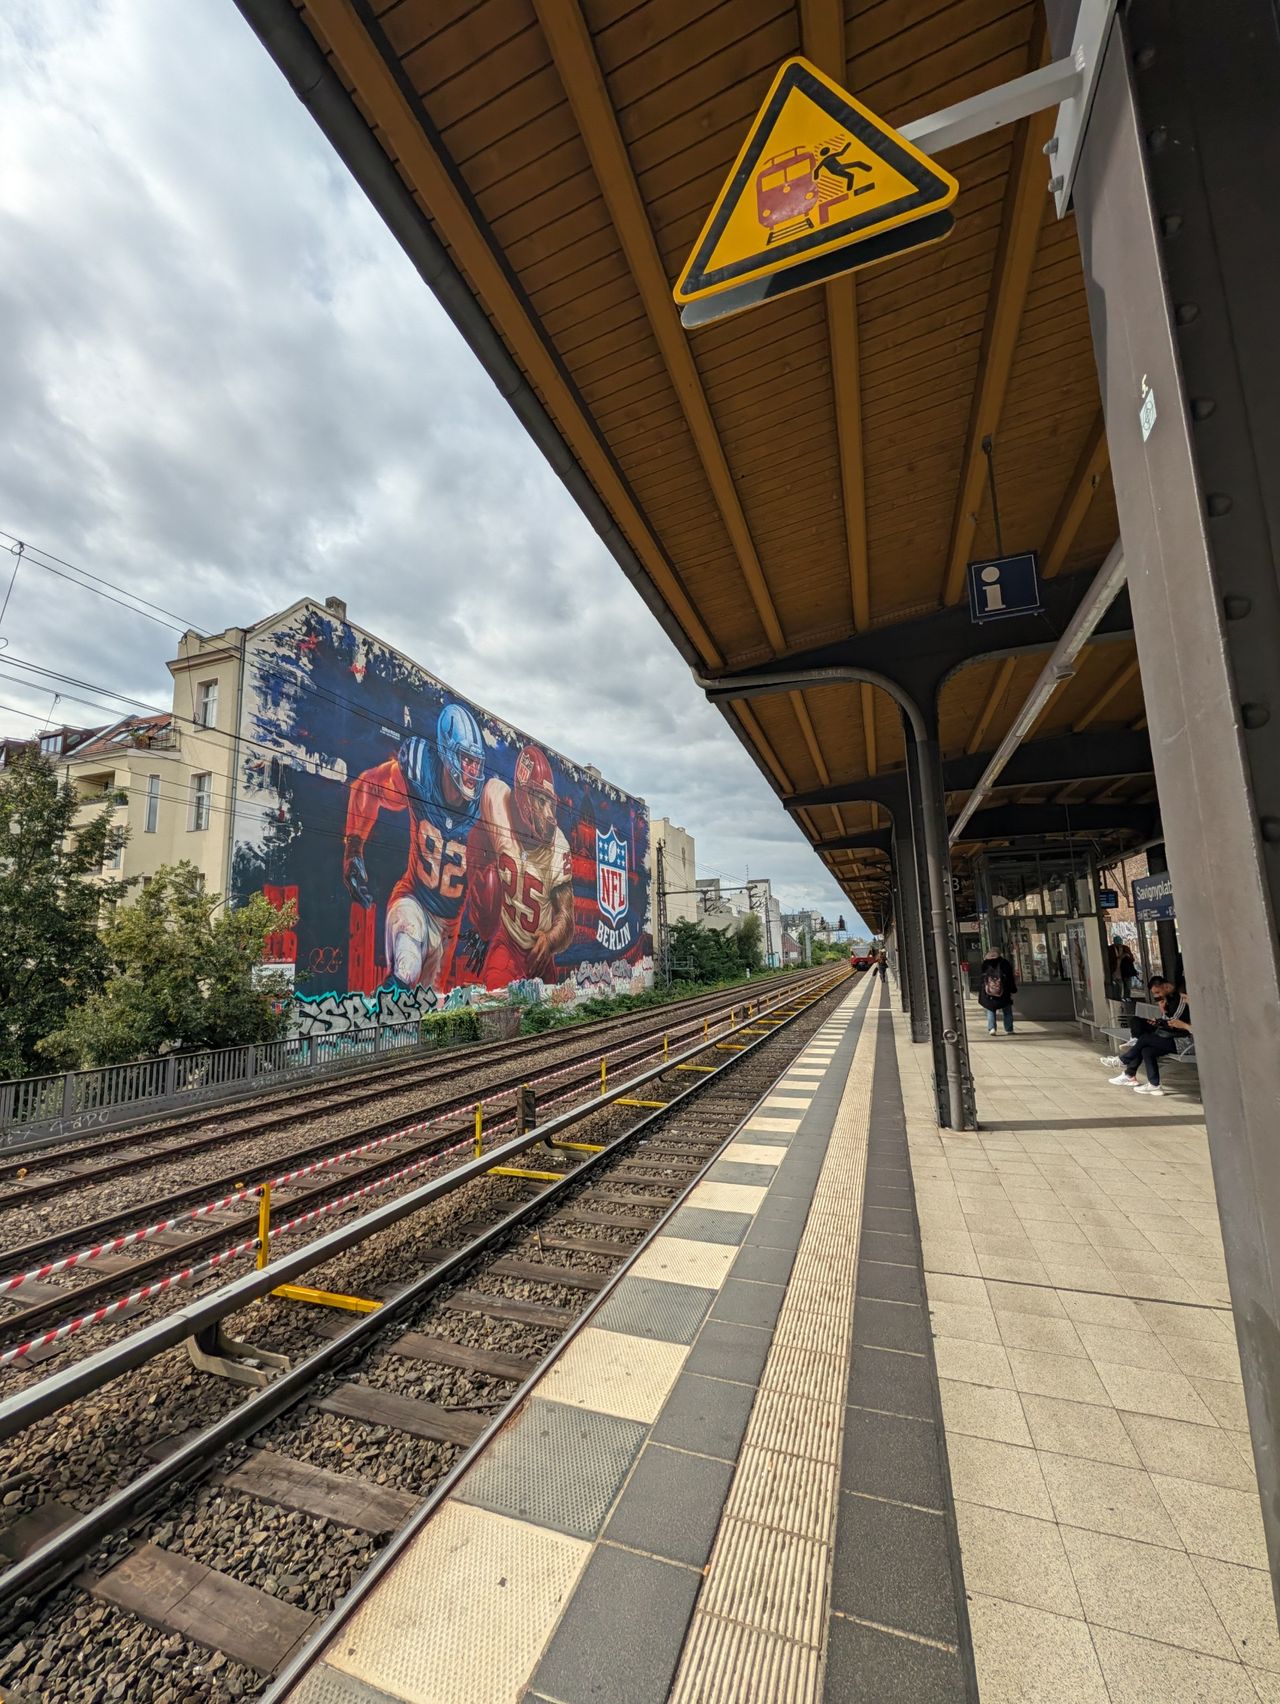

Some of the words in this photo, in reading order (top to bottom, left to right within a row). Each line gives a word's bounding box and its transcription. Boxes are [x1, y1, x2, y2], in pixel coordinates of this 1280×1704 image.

[416, 819, 467, 898] 92
[499, 851, 544, 934] 25
[600, 868, 625, 911] NFL
[1136, 880, 1173, 902] Savignyplat
[596, 920, 631, 950] BERLIN
